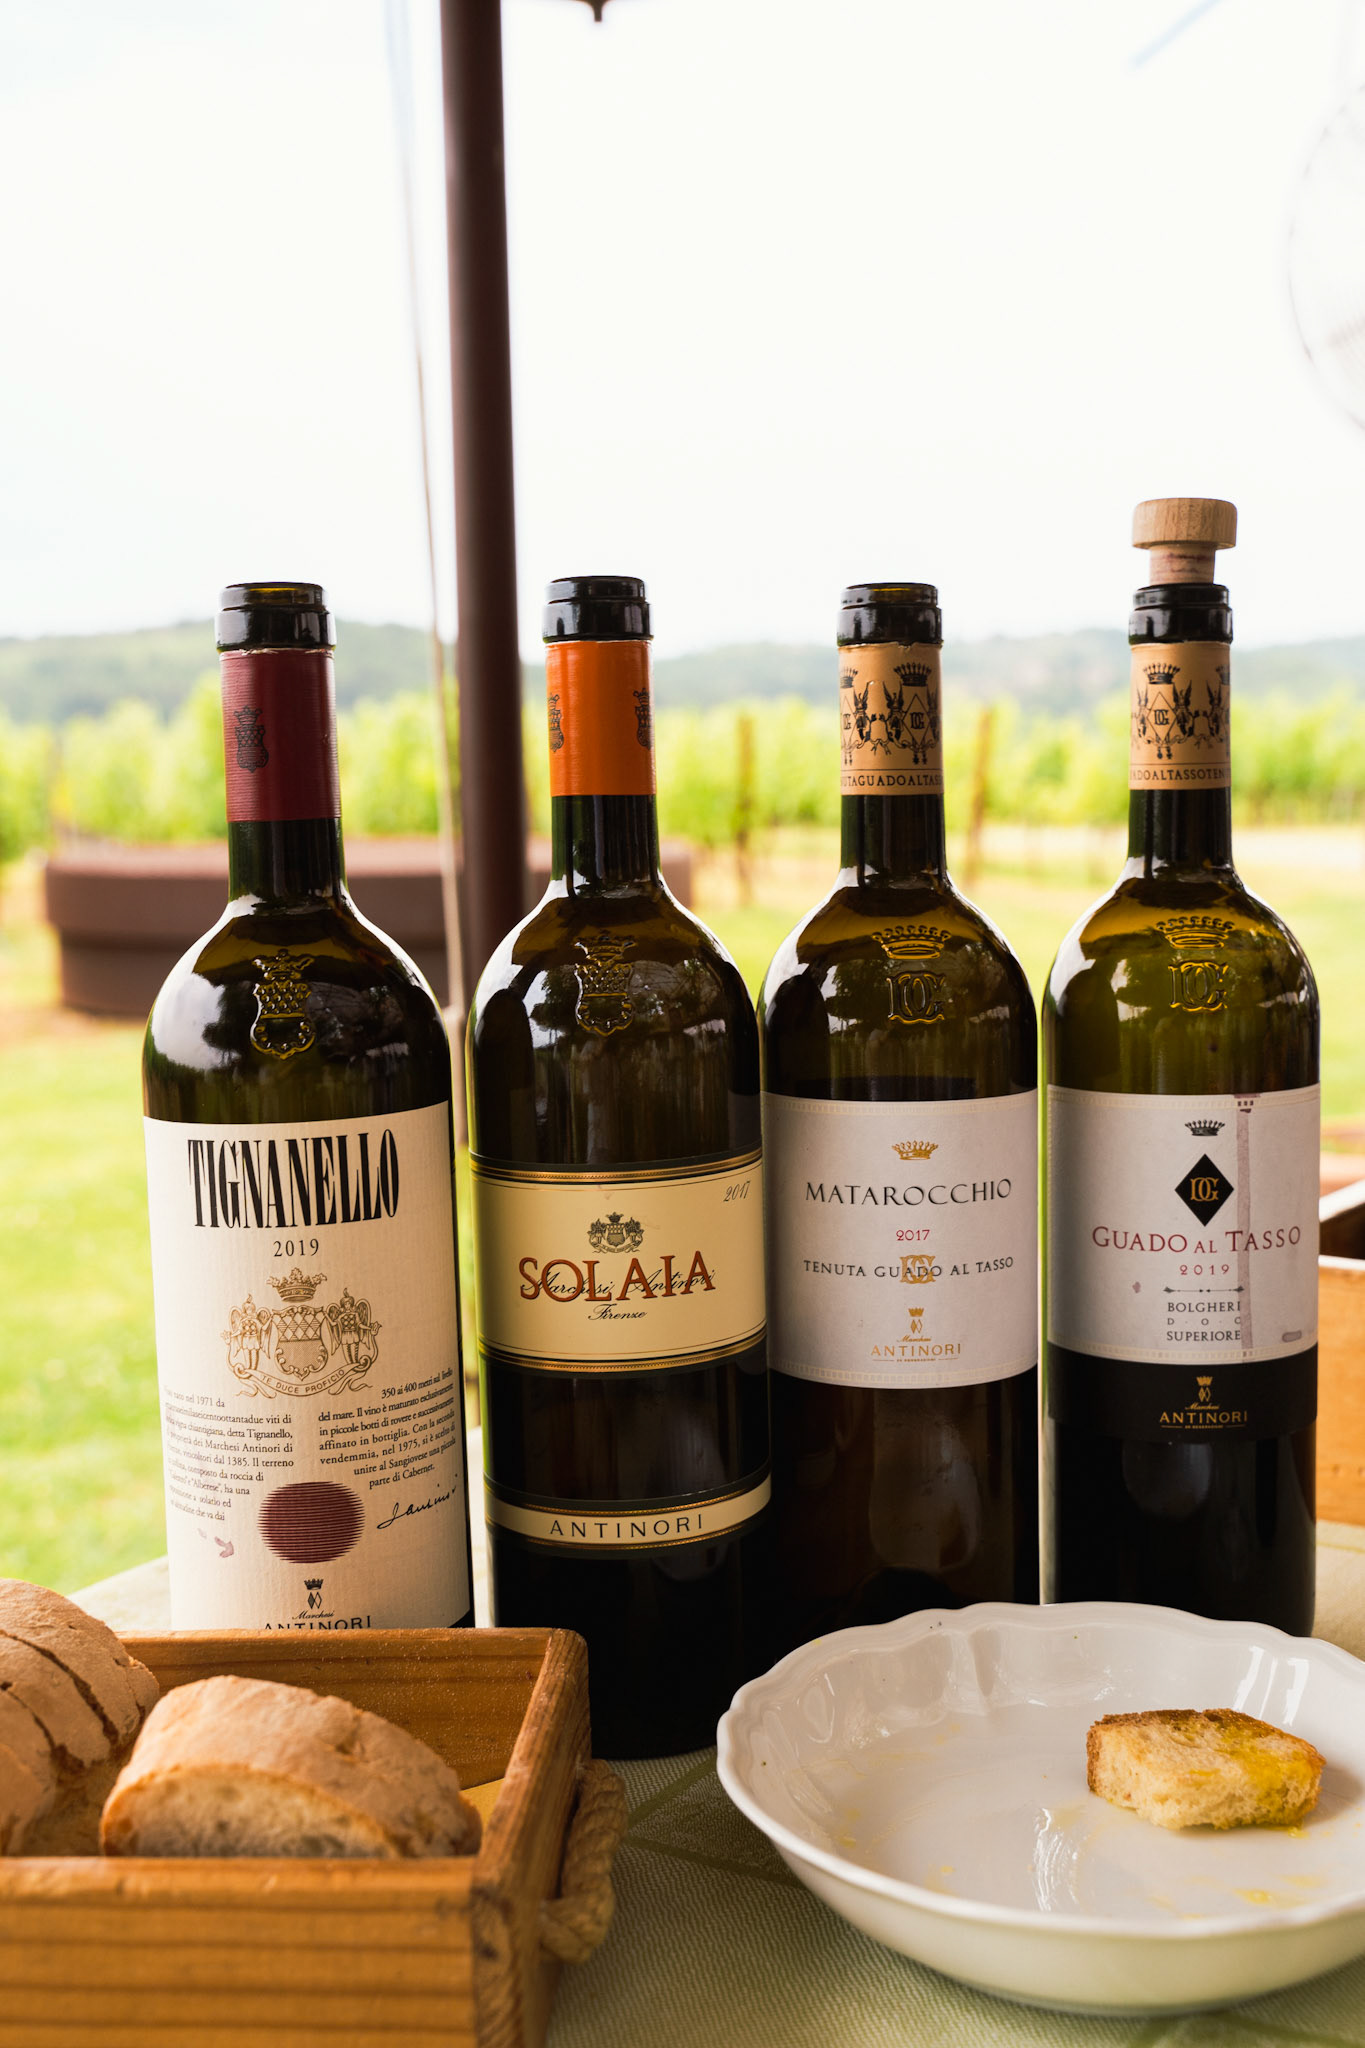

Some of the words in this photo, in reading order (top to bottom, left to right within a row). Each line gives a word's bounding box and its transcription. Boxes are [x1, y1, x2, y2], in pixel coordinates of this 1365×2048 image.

[187, 1128, 399, 1228] TIGNANELLO
[723, 1180, 751, 1202] 2017
[805, 1178, 1012, 1206] MATAROCCHIO
[896, 1229, 930, 1241] 2017
[273, 1238, 319, 1257] 2019
[1194, 1240, 1218, 1254] AL
[803, 1260, 867, 1277] TENUTA
[874, 1265, 942, 1278] GUADO
[950, 1264, 970, 1276] AL
[975, 1256, 1014, 1273] TASSO
[1180, 1264, 1230, 1276] 2019
[519, 1250, 716, 1302] SOLAIA
[588, 1303, 648, 1320] Firenze
[1167, 1301, 1241, 1313] BOLGHERI
[1166, 1330, 1241, 1342] SUPERIORE
[870, 1343, 961, 1357] ANTINORI
[262, 1375, 272, 1383] TE
[275, 1382, 299, 1394] DUCE
[305, 1370, 345, 1393] PROFICIO
[381, 1388, 396, 1400] 350
[396, 1385, 403, 1395] ai
[403, 1382, 417, 1393] 400
[196, 1396, 213, 1406] 1971
[216, 1398, 225, 1408] da
[318, 1412, 331, 1422] del
[332, 1412, 355, 1421] mare.
[357, 1407, 363, 1417] Il
[363, 1406, 381, 1416] vino
[382, 1403, 387, 1413] è
[388, 1398, 419, 1412] maturato
[266, 1414, 280, 1424] viti
[282, 1414, 292, 1424] di
[1160, 1410, 1248, 1424] ANTINORI
[319, 1426, 328, 1436] in
[330, 1423, 359, 1438] piccole
[360, 1420, 380, 1430] botti
[381, 1418, 389, 1428] di
[390, 1413, 412, 1425] rovere
[227, 1427, 245, 1438] detta
[248, 1428, 293, 1442] Tignanello,
[319, 1439, 357, 1451] affinato
[360, 1436, 369, 1446] in
[372, 1428, 410, 1444] bottiglia.
[412, 1423, 428, 1434] Con
[429, 1418, 436, 1428] la
[193, 1437, 203, 1448] dei
[205, 1439, 240, 1452] Marchesi
[242, 1443, 281, 1453] Antinori
[284, 1443, 293, 1453] di
[319, 1450, 379, 1465] vendemmia,
[382, 1445, 395, 1456] nel
[398, 1440, 420, 1453] 1975,
[422, 1436, 429, 1446] si
[429, 1433, 435, 1442] è
[214, 1454, 225, 1465] dal
[228, 1456, 250, 1467] 1385.
[253, 1457, 259, 1467] Il
[262, 1460, 294, 1468] terreno
[353, 1464, 377, 1476] unire
[379, 1460, 387, 1471] al
[389, 1451, 428, 1469] Sangiovese
[429, 1448, 440, 1457] una
[219, 1469, 228, 1480] da
[230, 1472, 253, 1481] roccia
[255, 1472, 264, 1481] di
[369, 1476, 390, 1490] parte
[392, 1473, 401, 1482] di
[402, 1464, 435, 1479] Cabernet.
[224, 1484, 233, 1495] ha
[235, 1486, 250, 1495] una
[222, 1499, 232, 1508] ed
[215, 1511, 226, 1521] dai
[550, 1513, 702, 1538] ANTINORI
[291, 1610, 335, 1620] Marchesi
